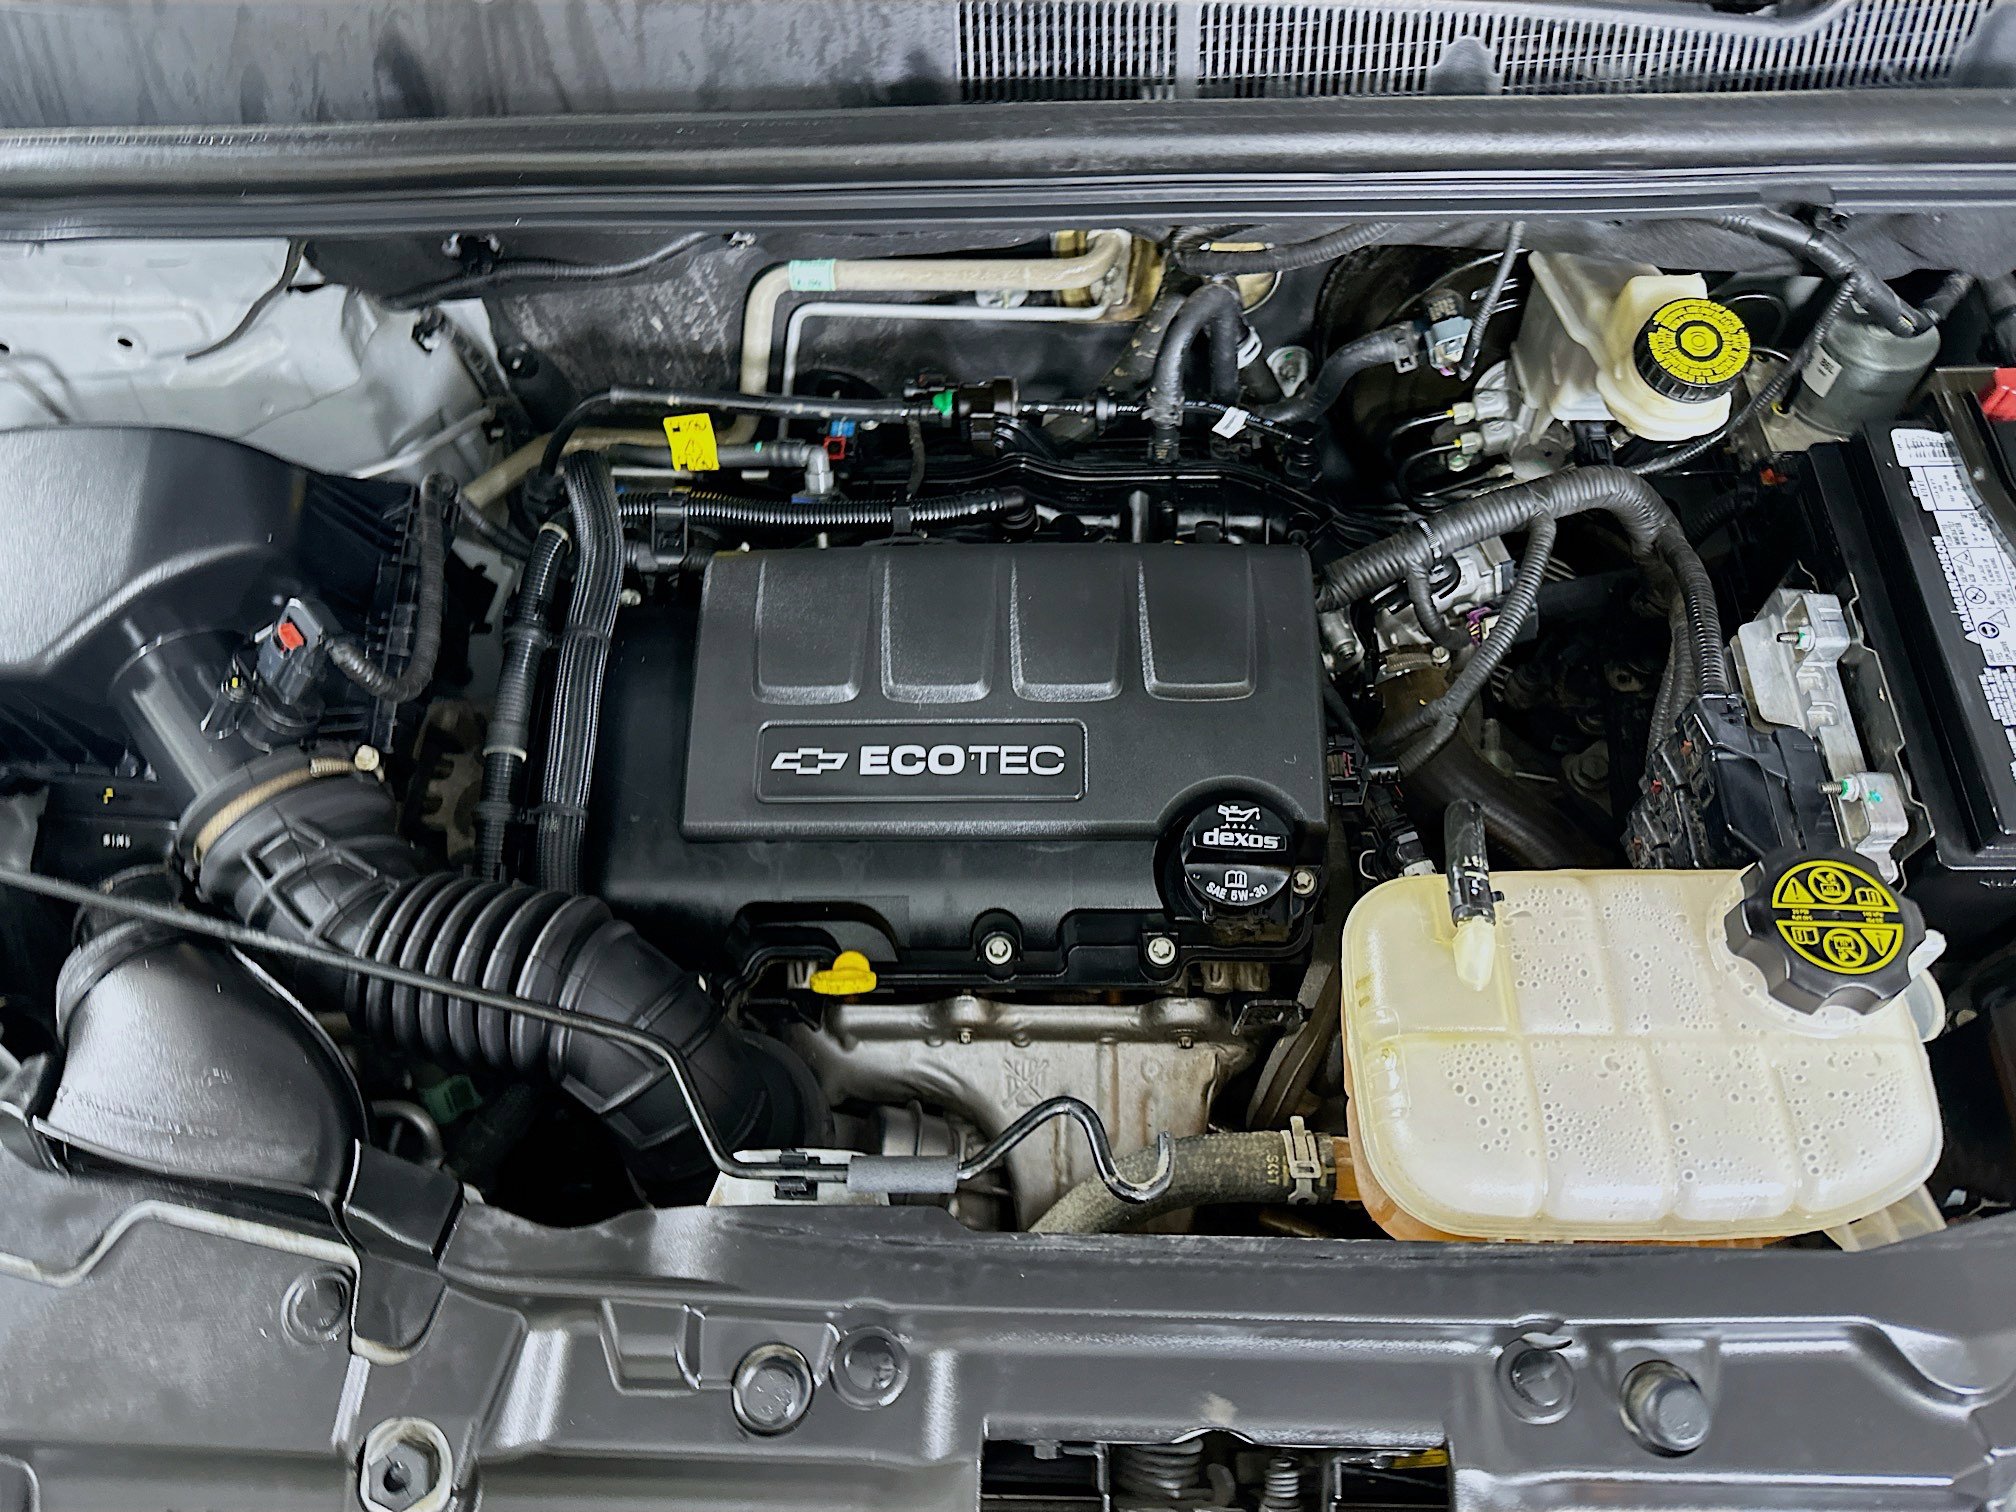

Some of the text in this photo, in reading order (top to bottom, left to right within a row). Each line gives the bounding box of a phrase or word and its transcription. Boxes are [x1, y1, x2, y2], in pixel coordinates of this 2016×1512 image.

[859, 744, 1065, 776] ECOTEC
[1202, 827, 1280, 850] dexos
[1206, 881, 1227, 900] SAE
